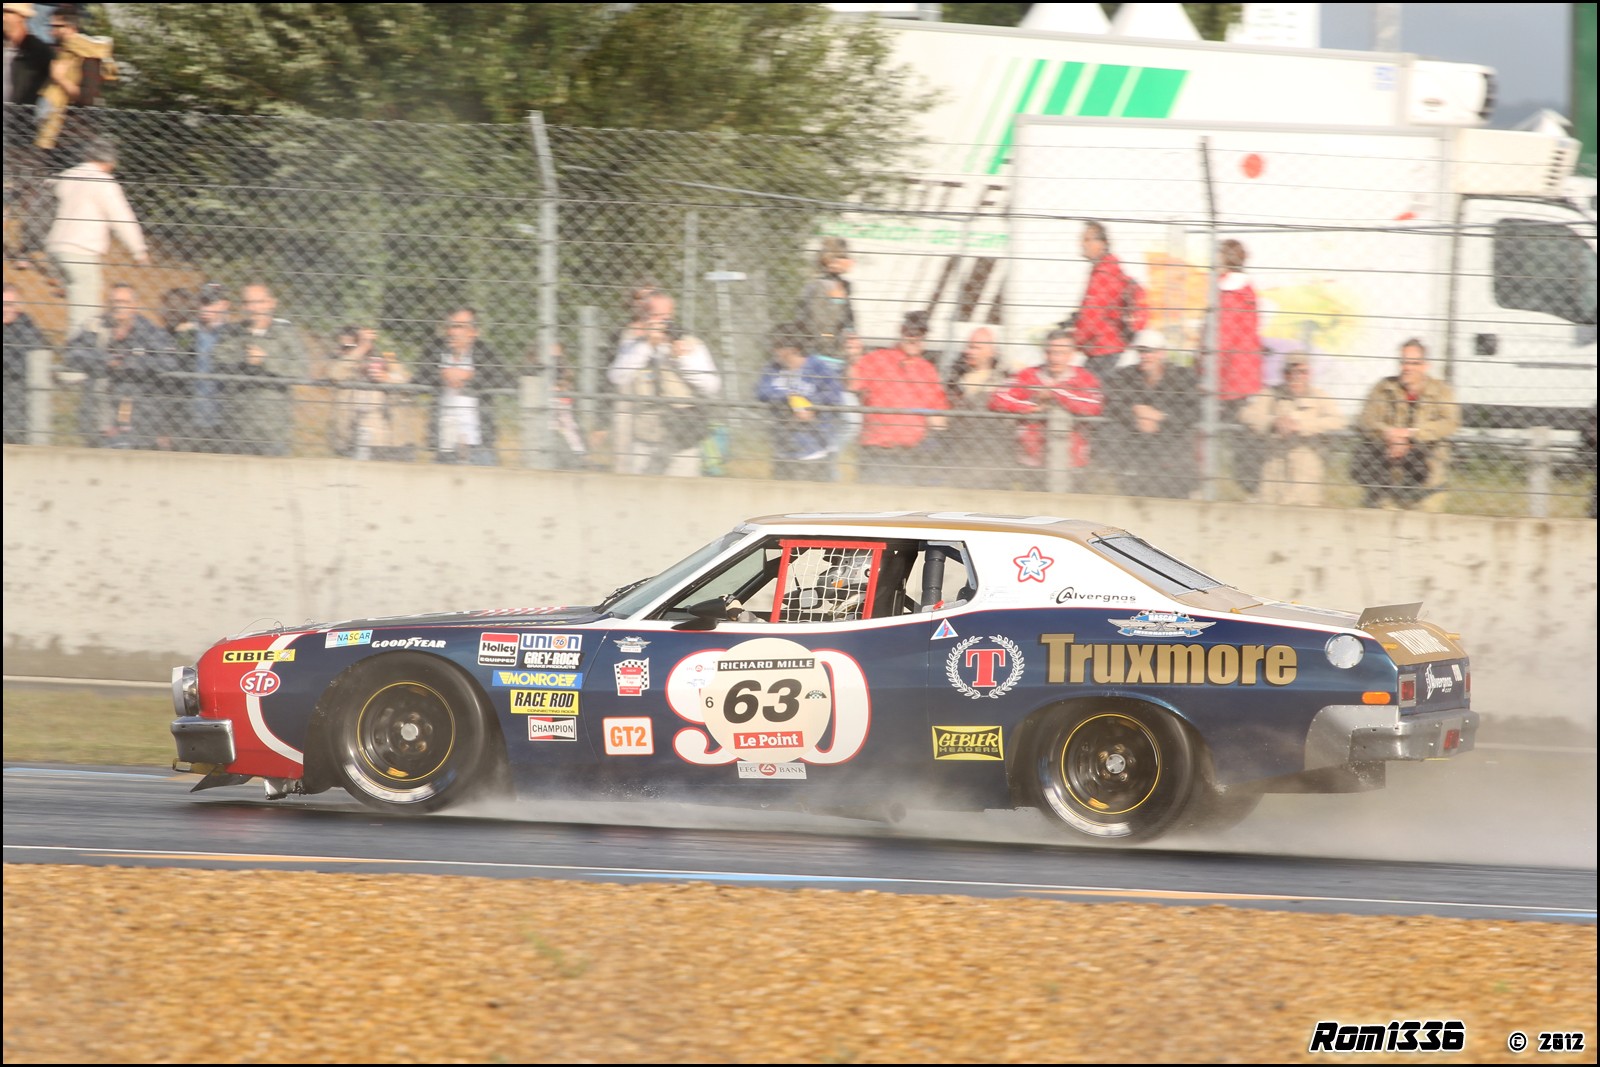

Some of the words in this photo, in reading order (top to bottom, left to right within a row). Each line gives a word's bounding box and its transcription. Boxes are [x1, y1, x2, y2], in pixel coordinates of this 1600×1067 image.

[1056, 586, 1136, 604] Alvergnas
[337, 632, 371, 642] NASCAR
[555, 638, 565, 646] 76
[482, 642, 516, 655] Holley
[480, 656, 516, 664] EQUIPPED
[524, 651, 581, 666] GREY-ROCK
[720, 660, 774, 671] RICHARD
[777, 659, 814, 669] MILLE
[1039, 633, 1298, 687] Truxmore
[965, 649, 1006, 688] T
[244, 672, 276, 692] STP
[507, 672, 567, 686] MONROE
[514, 691, 548, 707] RACE
[549, 692, 575, 708] ROD
[705, 696, 714, 709] 6
[722, 678, 803, 724] 63
[532, 724, 573, 733] CHAMPION
[610, 726, 647, 748] GT2
[739, 735, 757, 748] Le
[758, 733, 799, 747] Point
[938, 732, 999, 747] GEBLER
[739, 765, 757, 774] EFG
[779, 766, 804, 774] BANK
